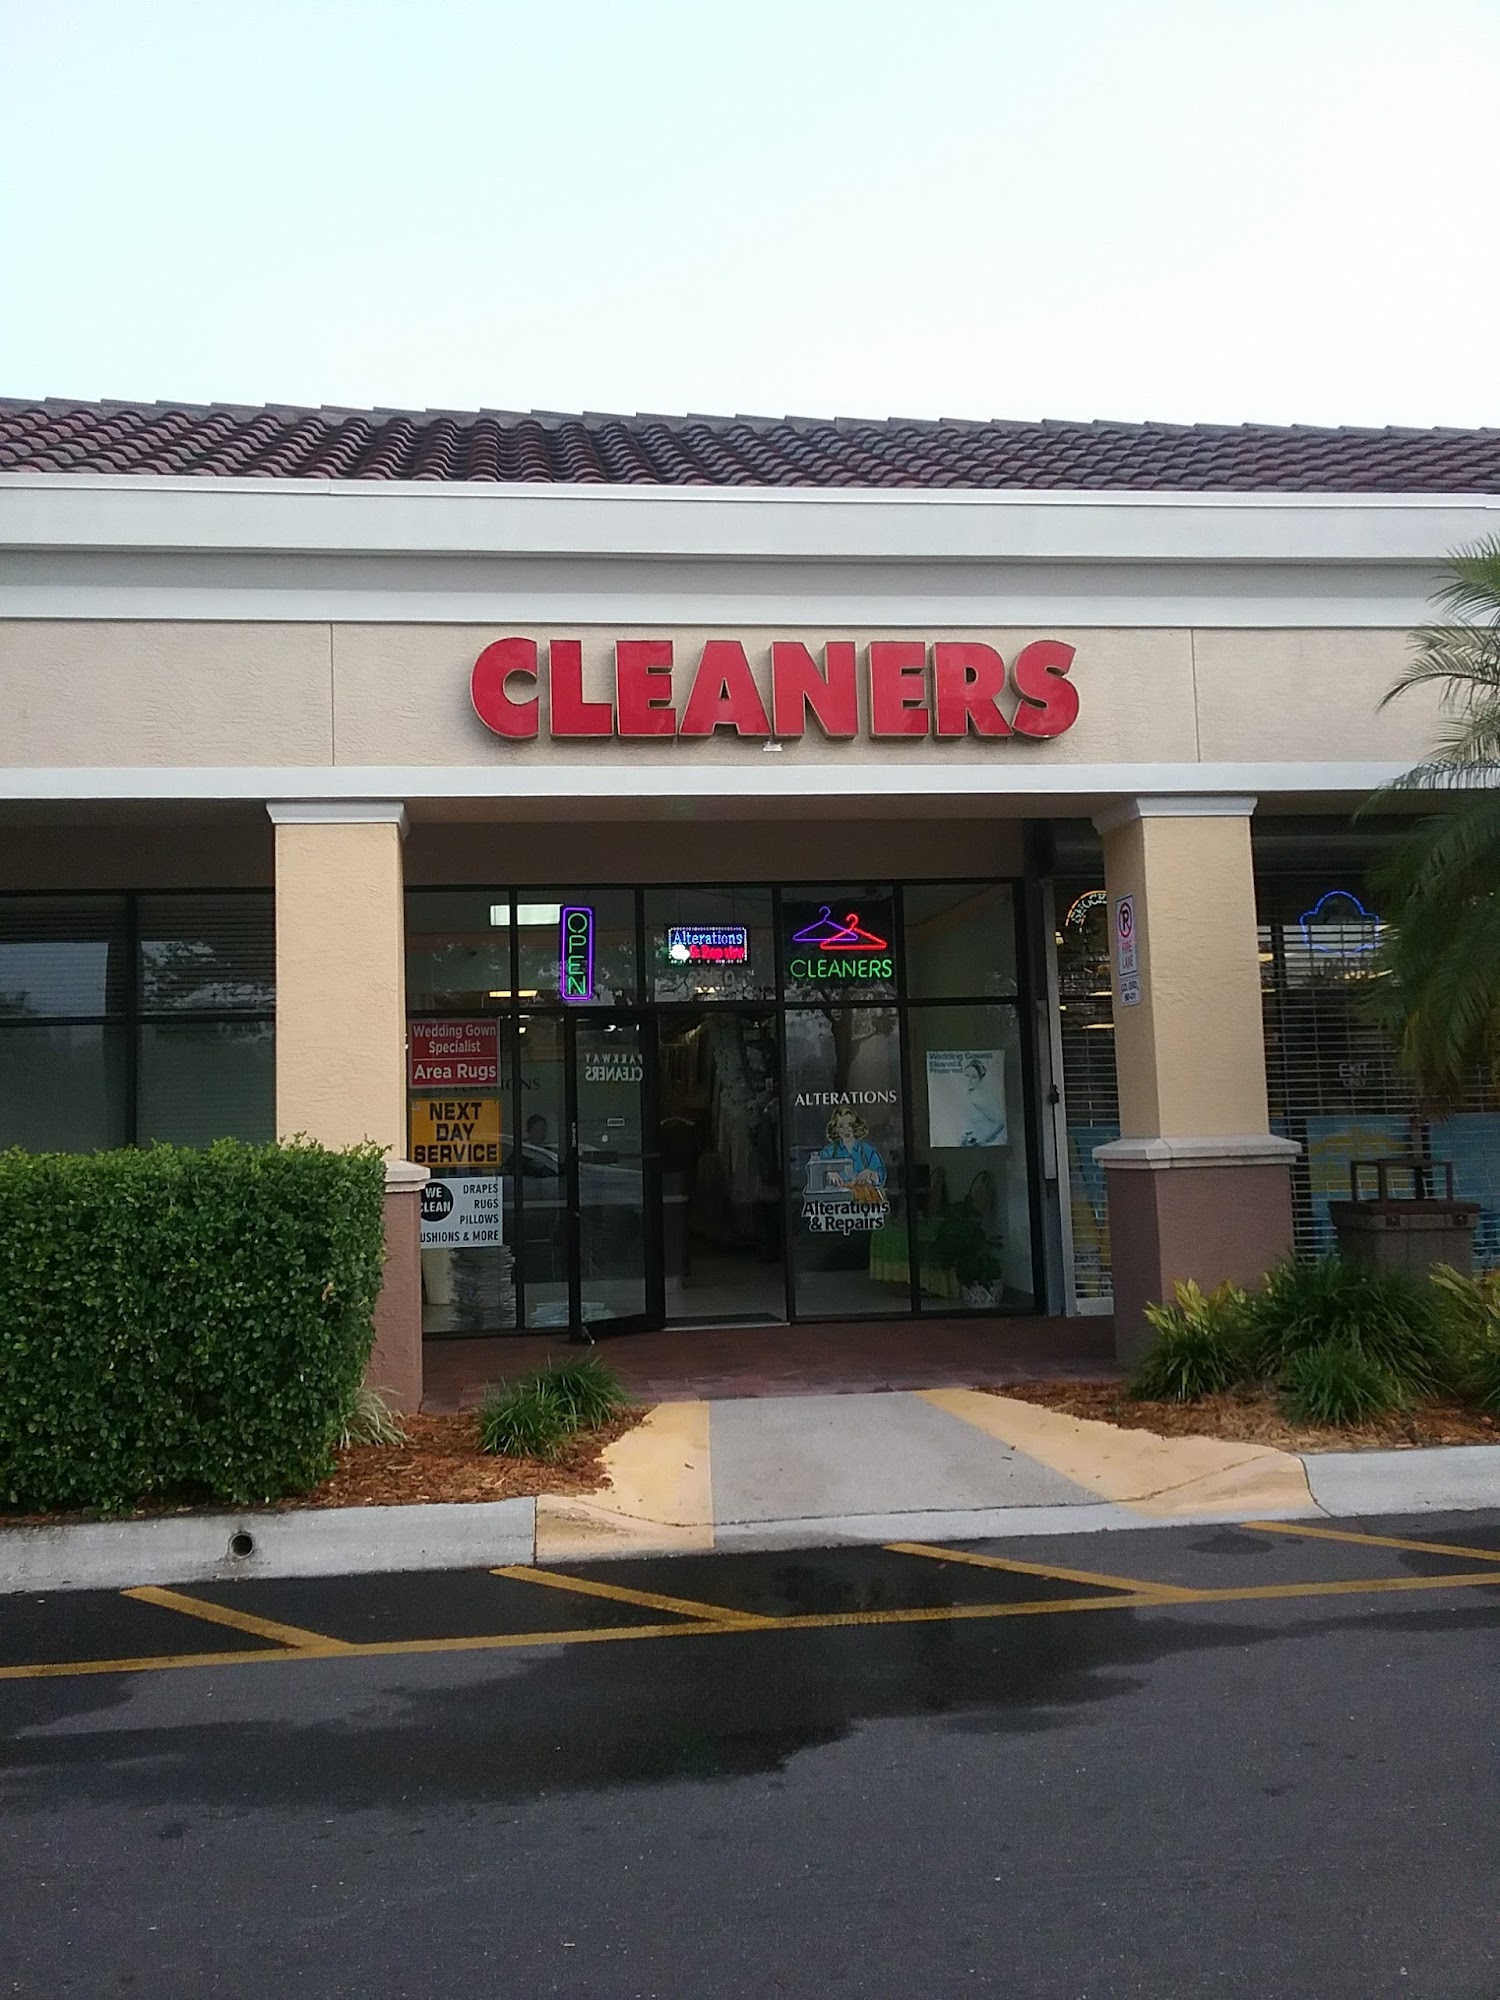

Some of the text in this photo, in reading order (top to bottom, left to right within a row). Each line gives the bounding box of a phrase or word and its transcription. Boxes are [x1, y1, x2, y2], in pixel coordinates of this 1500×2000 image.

[470, 637, 1081, 740] CLEANERS
[672, 930, 743, 945] Alterations
[567, 912, 588, 995] OPEN
[790, 958, 893, 979] CLEANERS
[413, 1023, 496, 1039] Wedding Gown
[428, 1040, 481, 1056] Specialist
[929, 1052, 963, 1061] Wedding
[413, 1063, 497, 1081] Area Rugs
[1338, 1062, 1369, 1077] EXIT
[795, 1090, 897, 1106] ALTERATIONS
[429, 1102, 482, 1121] NEXT
[436, 1123, 475, 1141] DAY
[414, 1144, 497, 1162] SERVICE
[425, 1187, 442, 1198] WE
[463, 1184, 499, 1194] DRAPES
[474, 1199, 499, 1209] RUGS
[803, 1201, 889, 1216] Alterations
[460, 1214, 499, 1225] PILLOWS
[810, 1215, 883, 1234] & Repairs
[421, 1231, 499, 1243] USHIONS & MORE
